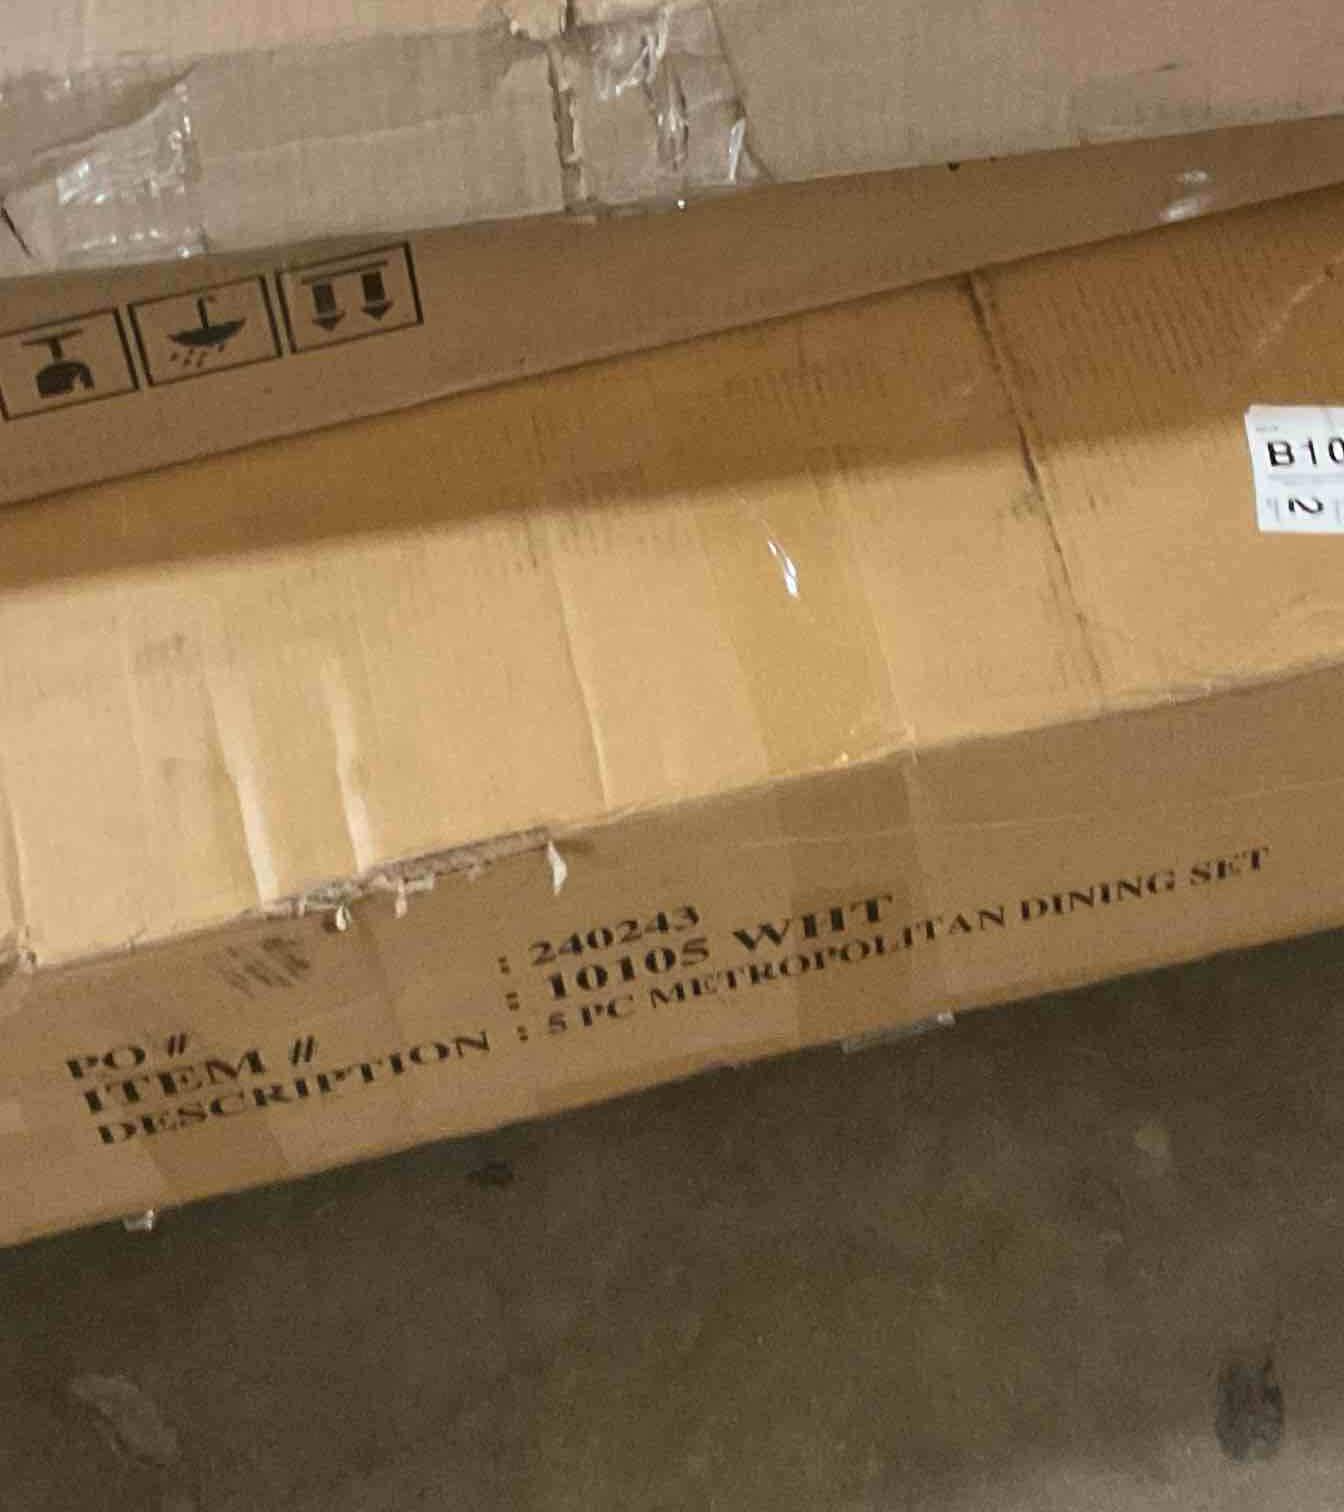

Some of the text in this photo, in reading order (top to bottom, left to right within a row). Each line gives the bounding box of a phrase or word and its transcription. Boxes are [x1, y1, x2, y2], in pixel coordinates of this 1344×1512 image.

[65, 1044, 148, 1082] PO
[529, 904, 700, 968] 240243
[81, 1046, 267, 1117] ITEM
[545, 935, 710, 1002] 10105
[731, 893, 894, 953] WHT
[94, 1029, 492, 1146] DESCRIPTION
[546, 1012, 569, 1036] 5
[581, 992, 635, 1029] PC
[649, 904, 1009, 1006] METROPOLITAN
[1019, 868, 1177, 922] DINING
[1187, 845, 1271, 888] SET
